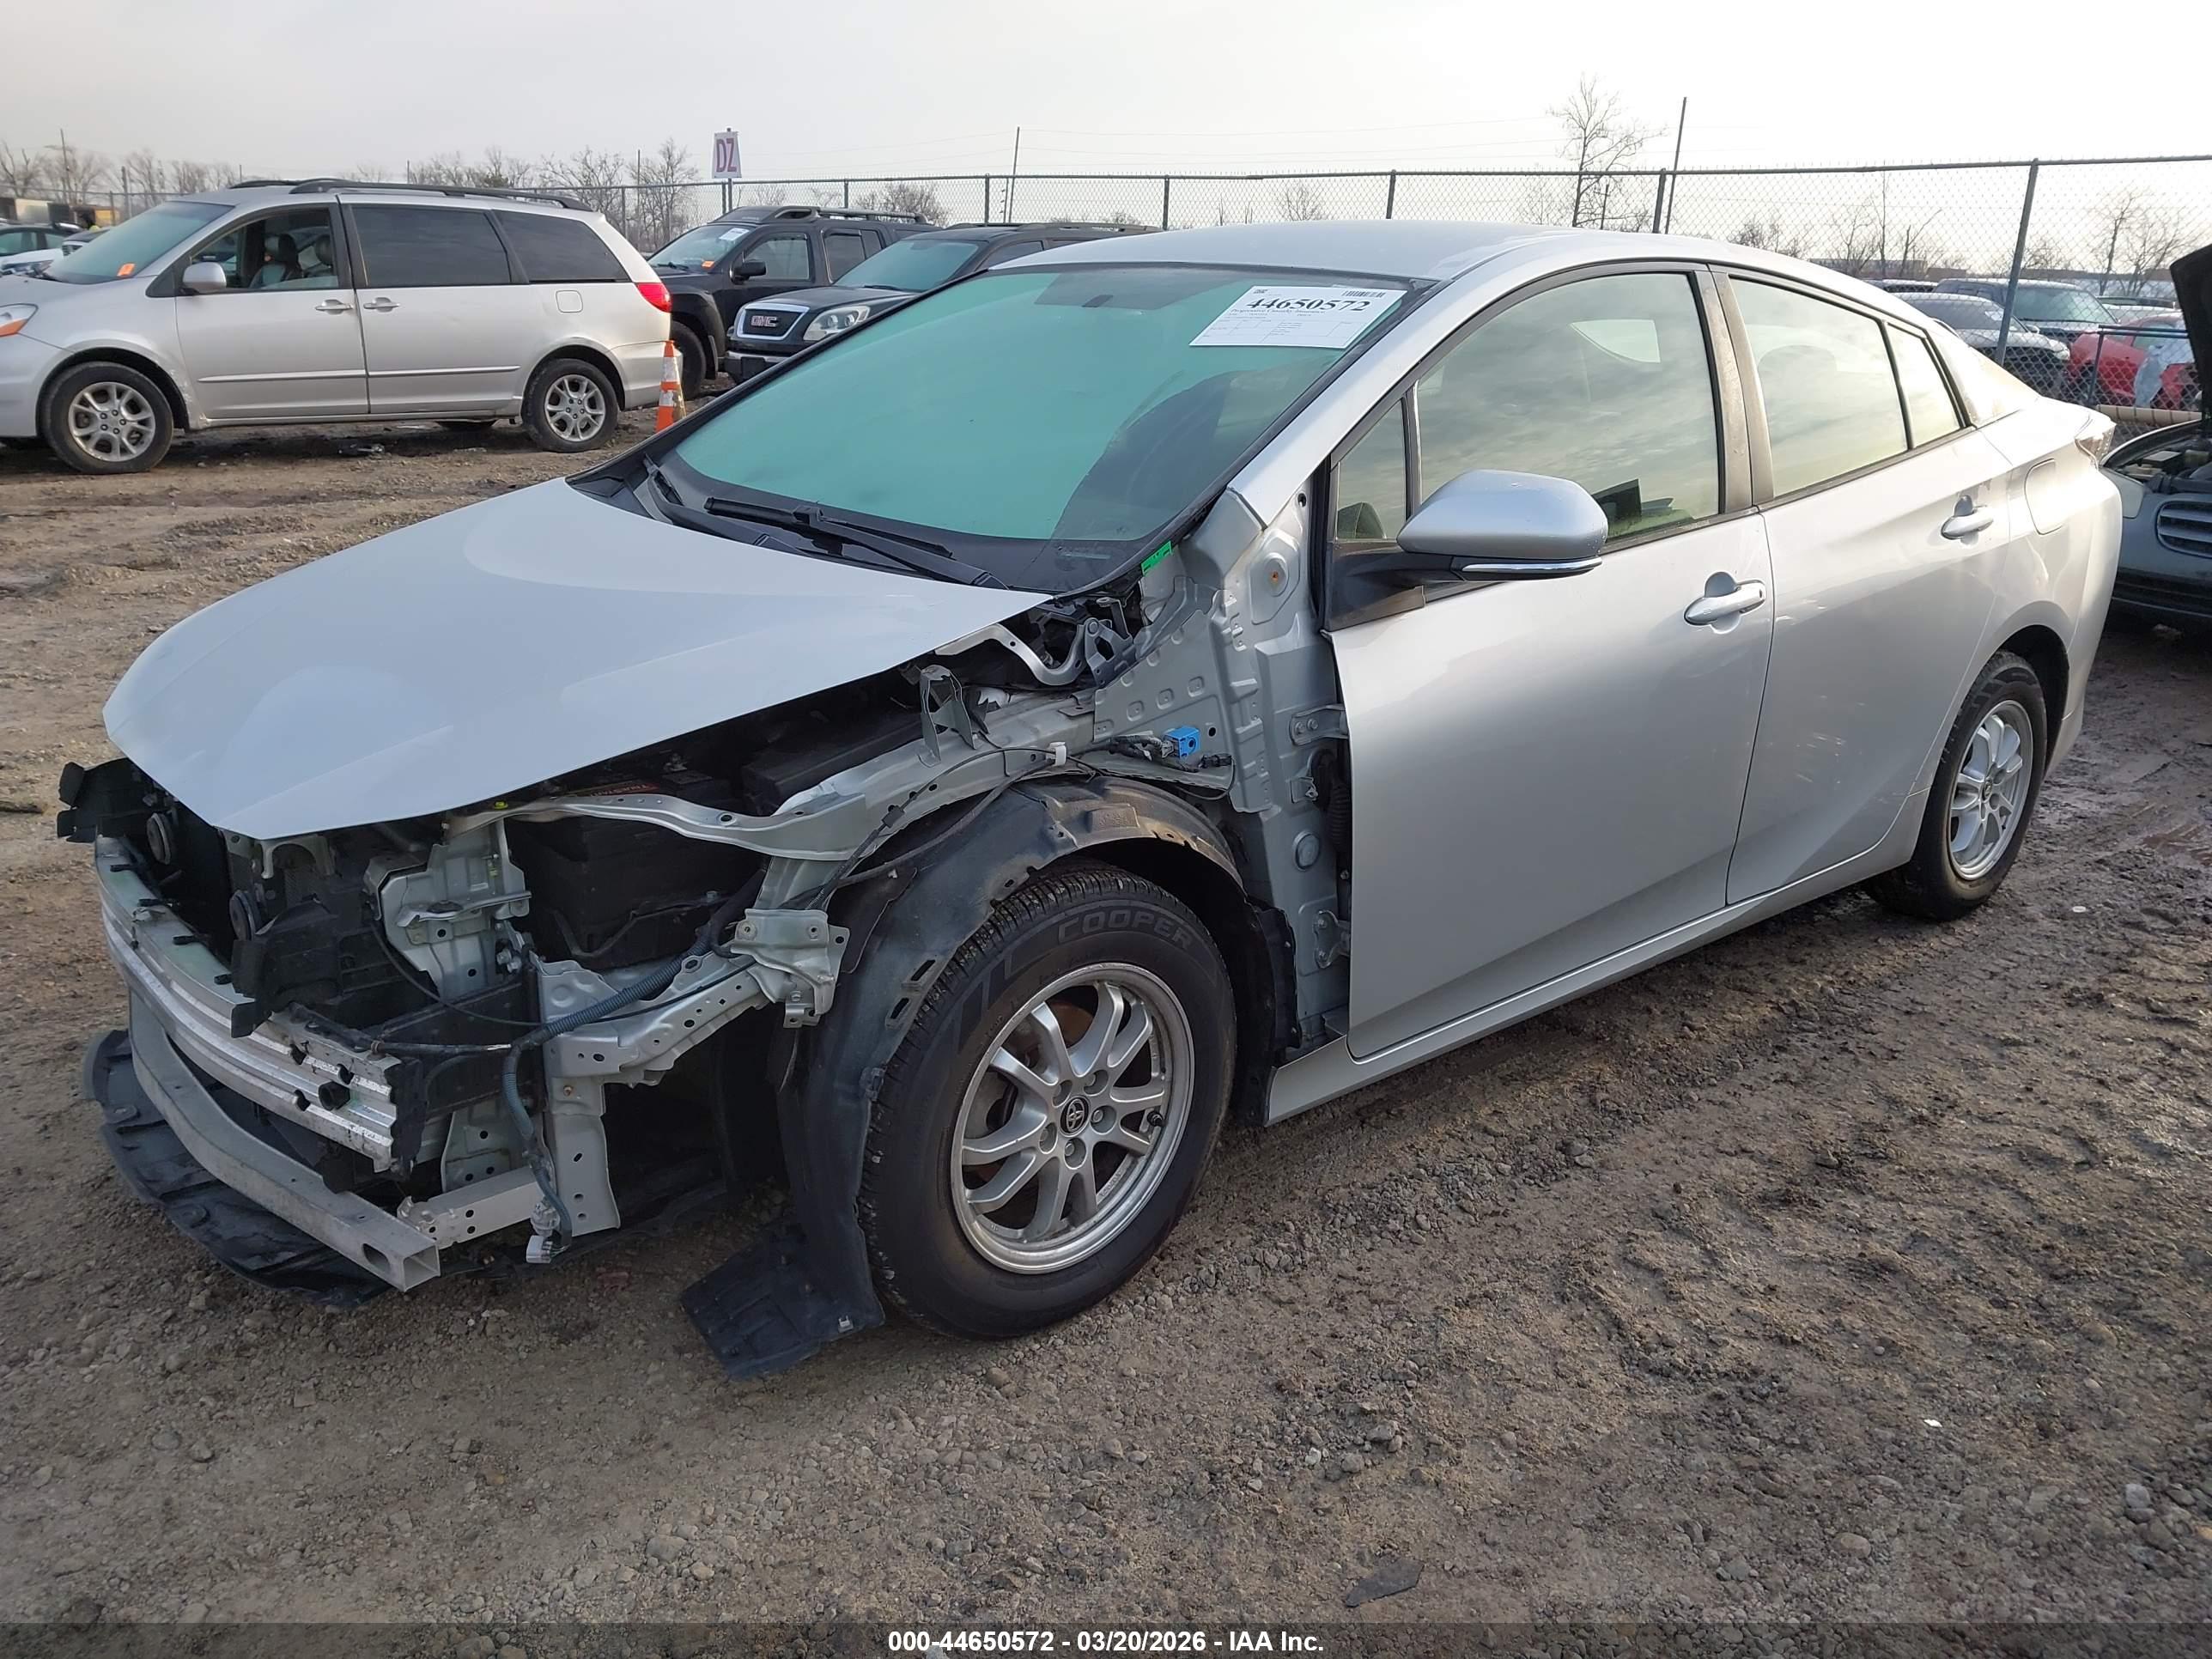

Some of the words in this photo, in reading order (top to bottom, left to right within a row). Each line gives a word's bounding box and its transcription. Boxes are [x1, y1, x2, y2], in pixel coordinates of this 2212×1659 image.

[716, 137, 737, 172] DZ
[1247, 298, 1370, 311] 44650572
[750, 315, 777, 327] GMC
[1058, 909, 1193, 949] COOPER
